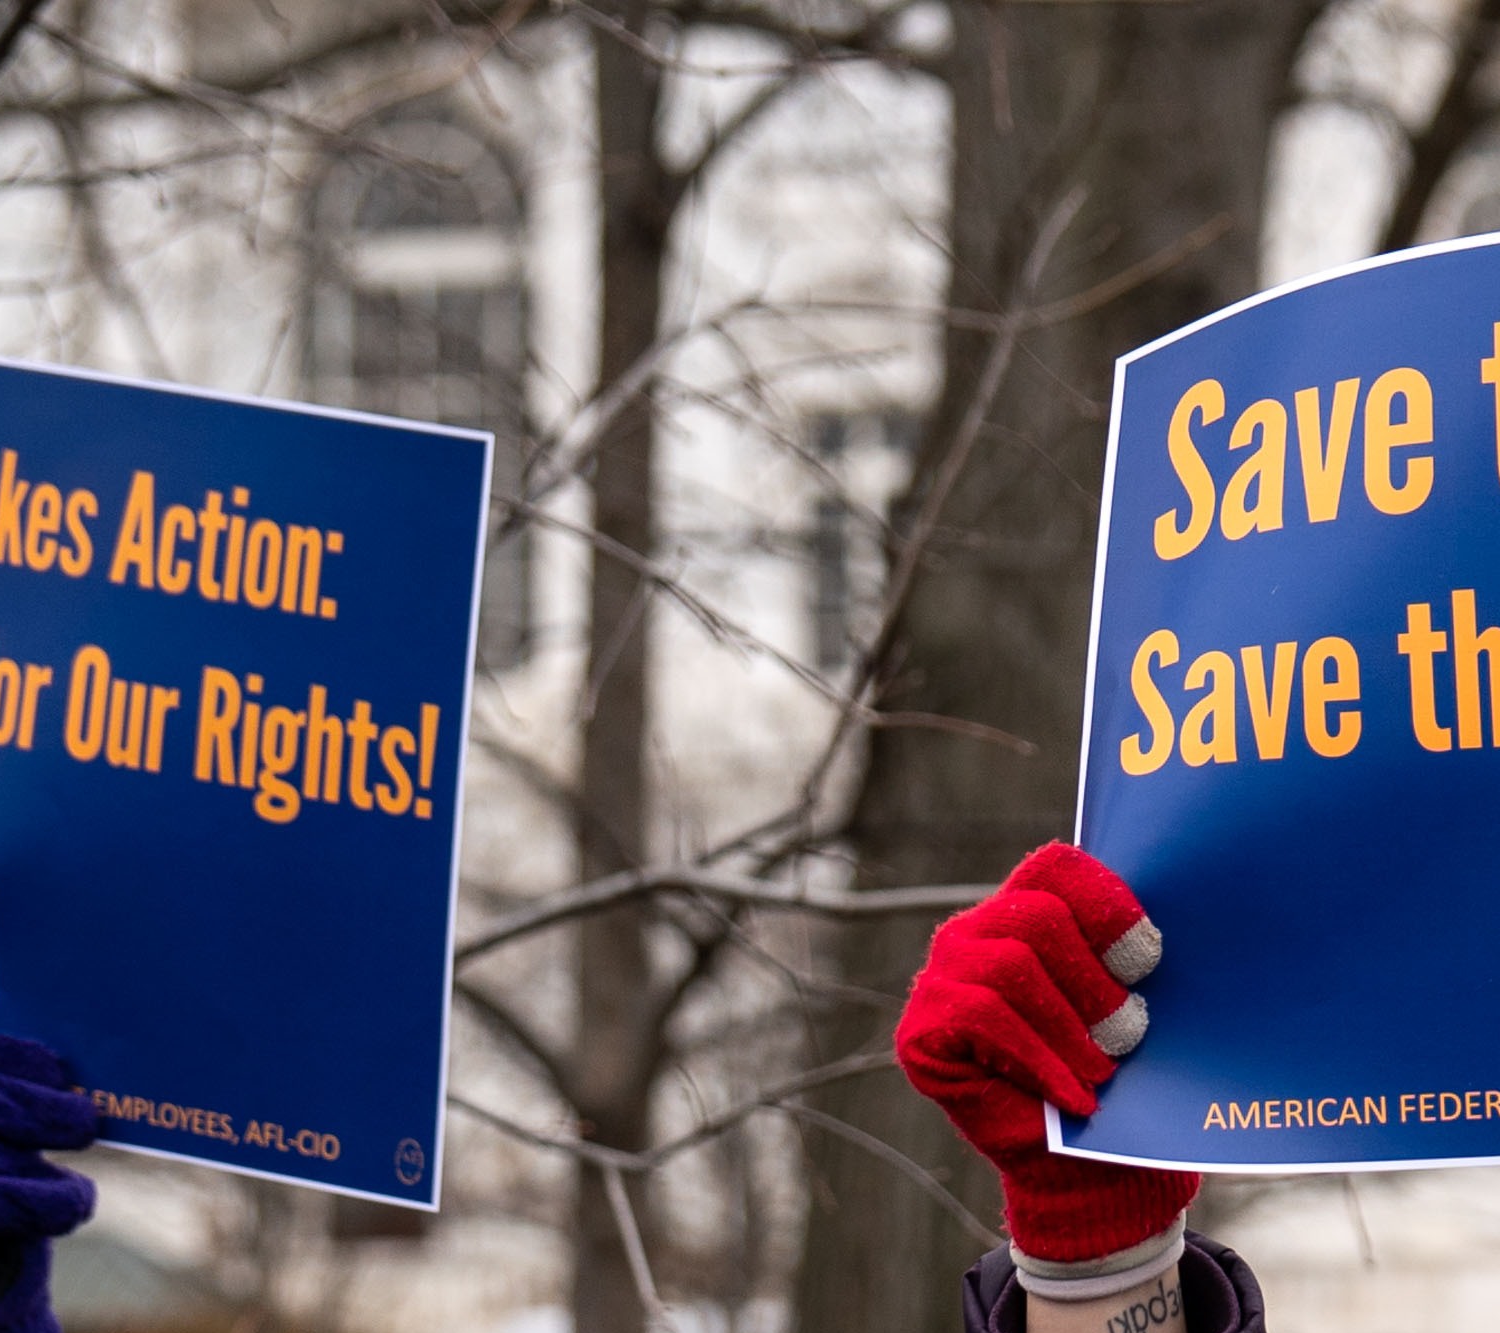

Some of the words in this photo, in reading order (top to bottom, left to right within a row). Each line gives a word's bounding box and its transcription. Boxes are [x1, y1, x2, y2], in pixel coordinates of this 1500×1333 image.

[1154, 375, 1434, 560] Save
[109, 471, 343, 618] Action:
[65, 646, 179, 772] Our
[195, 667, 439, 822] Rights!
[1120, 630, 1362, 775] Save
[242, 1116, 343, 1162] AFL-CIO
[1203, 1096, 1388, 1131] AMERICAN
